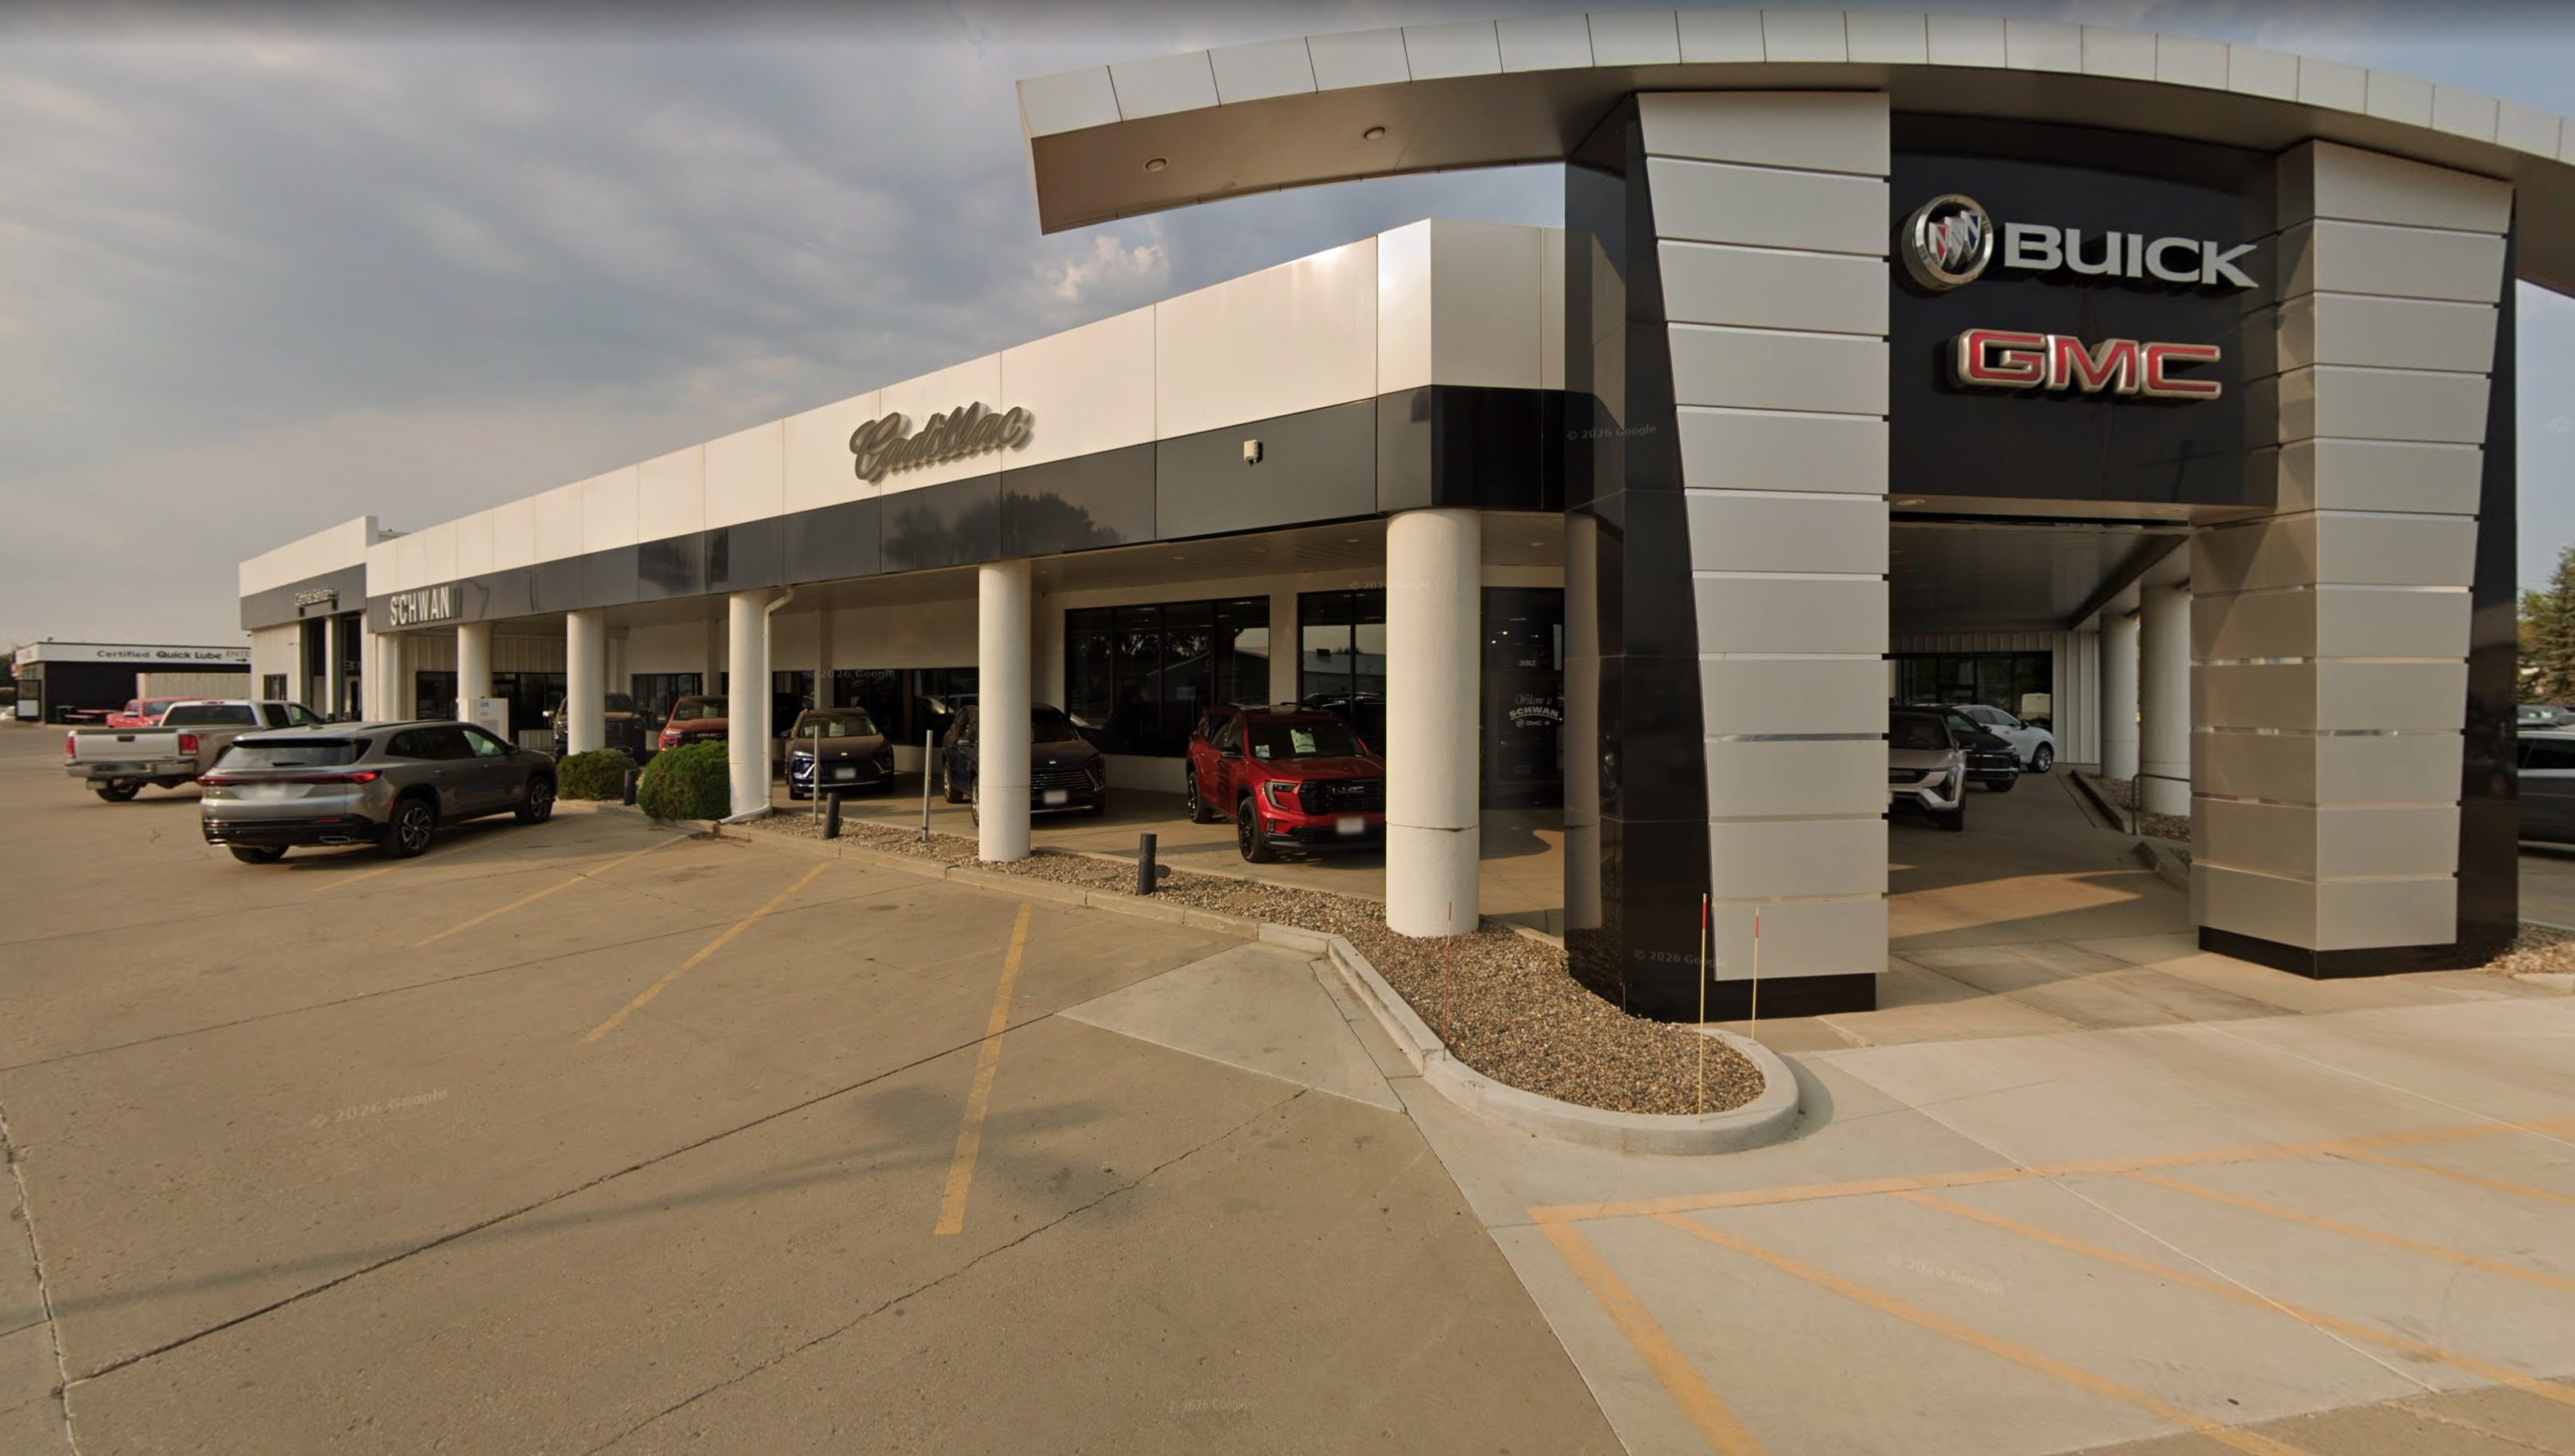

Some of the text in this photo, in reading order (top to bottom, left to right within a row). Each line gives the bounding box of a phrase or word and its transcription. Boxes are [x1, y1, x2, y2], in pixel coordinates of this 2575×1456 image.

[2004, 221, 2259, 288] BUICK
[1959, 328, 2221, 400] GMC
[850, 401, 1028, 482] Cadillac
[390, 587, 450, 627] SCHWAN
[97, 649, 150, 659] Certified
[156, 649, 192, 659] Quick
[194, 651, 222, 660] Lube
[1508, 706, 1559, 718] SCHWAN
[1515, 693, 1544, 705] Welcome
